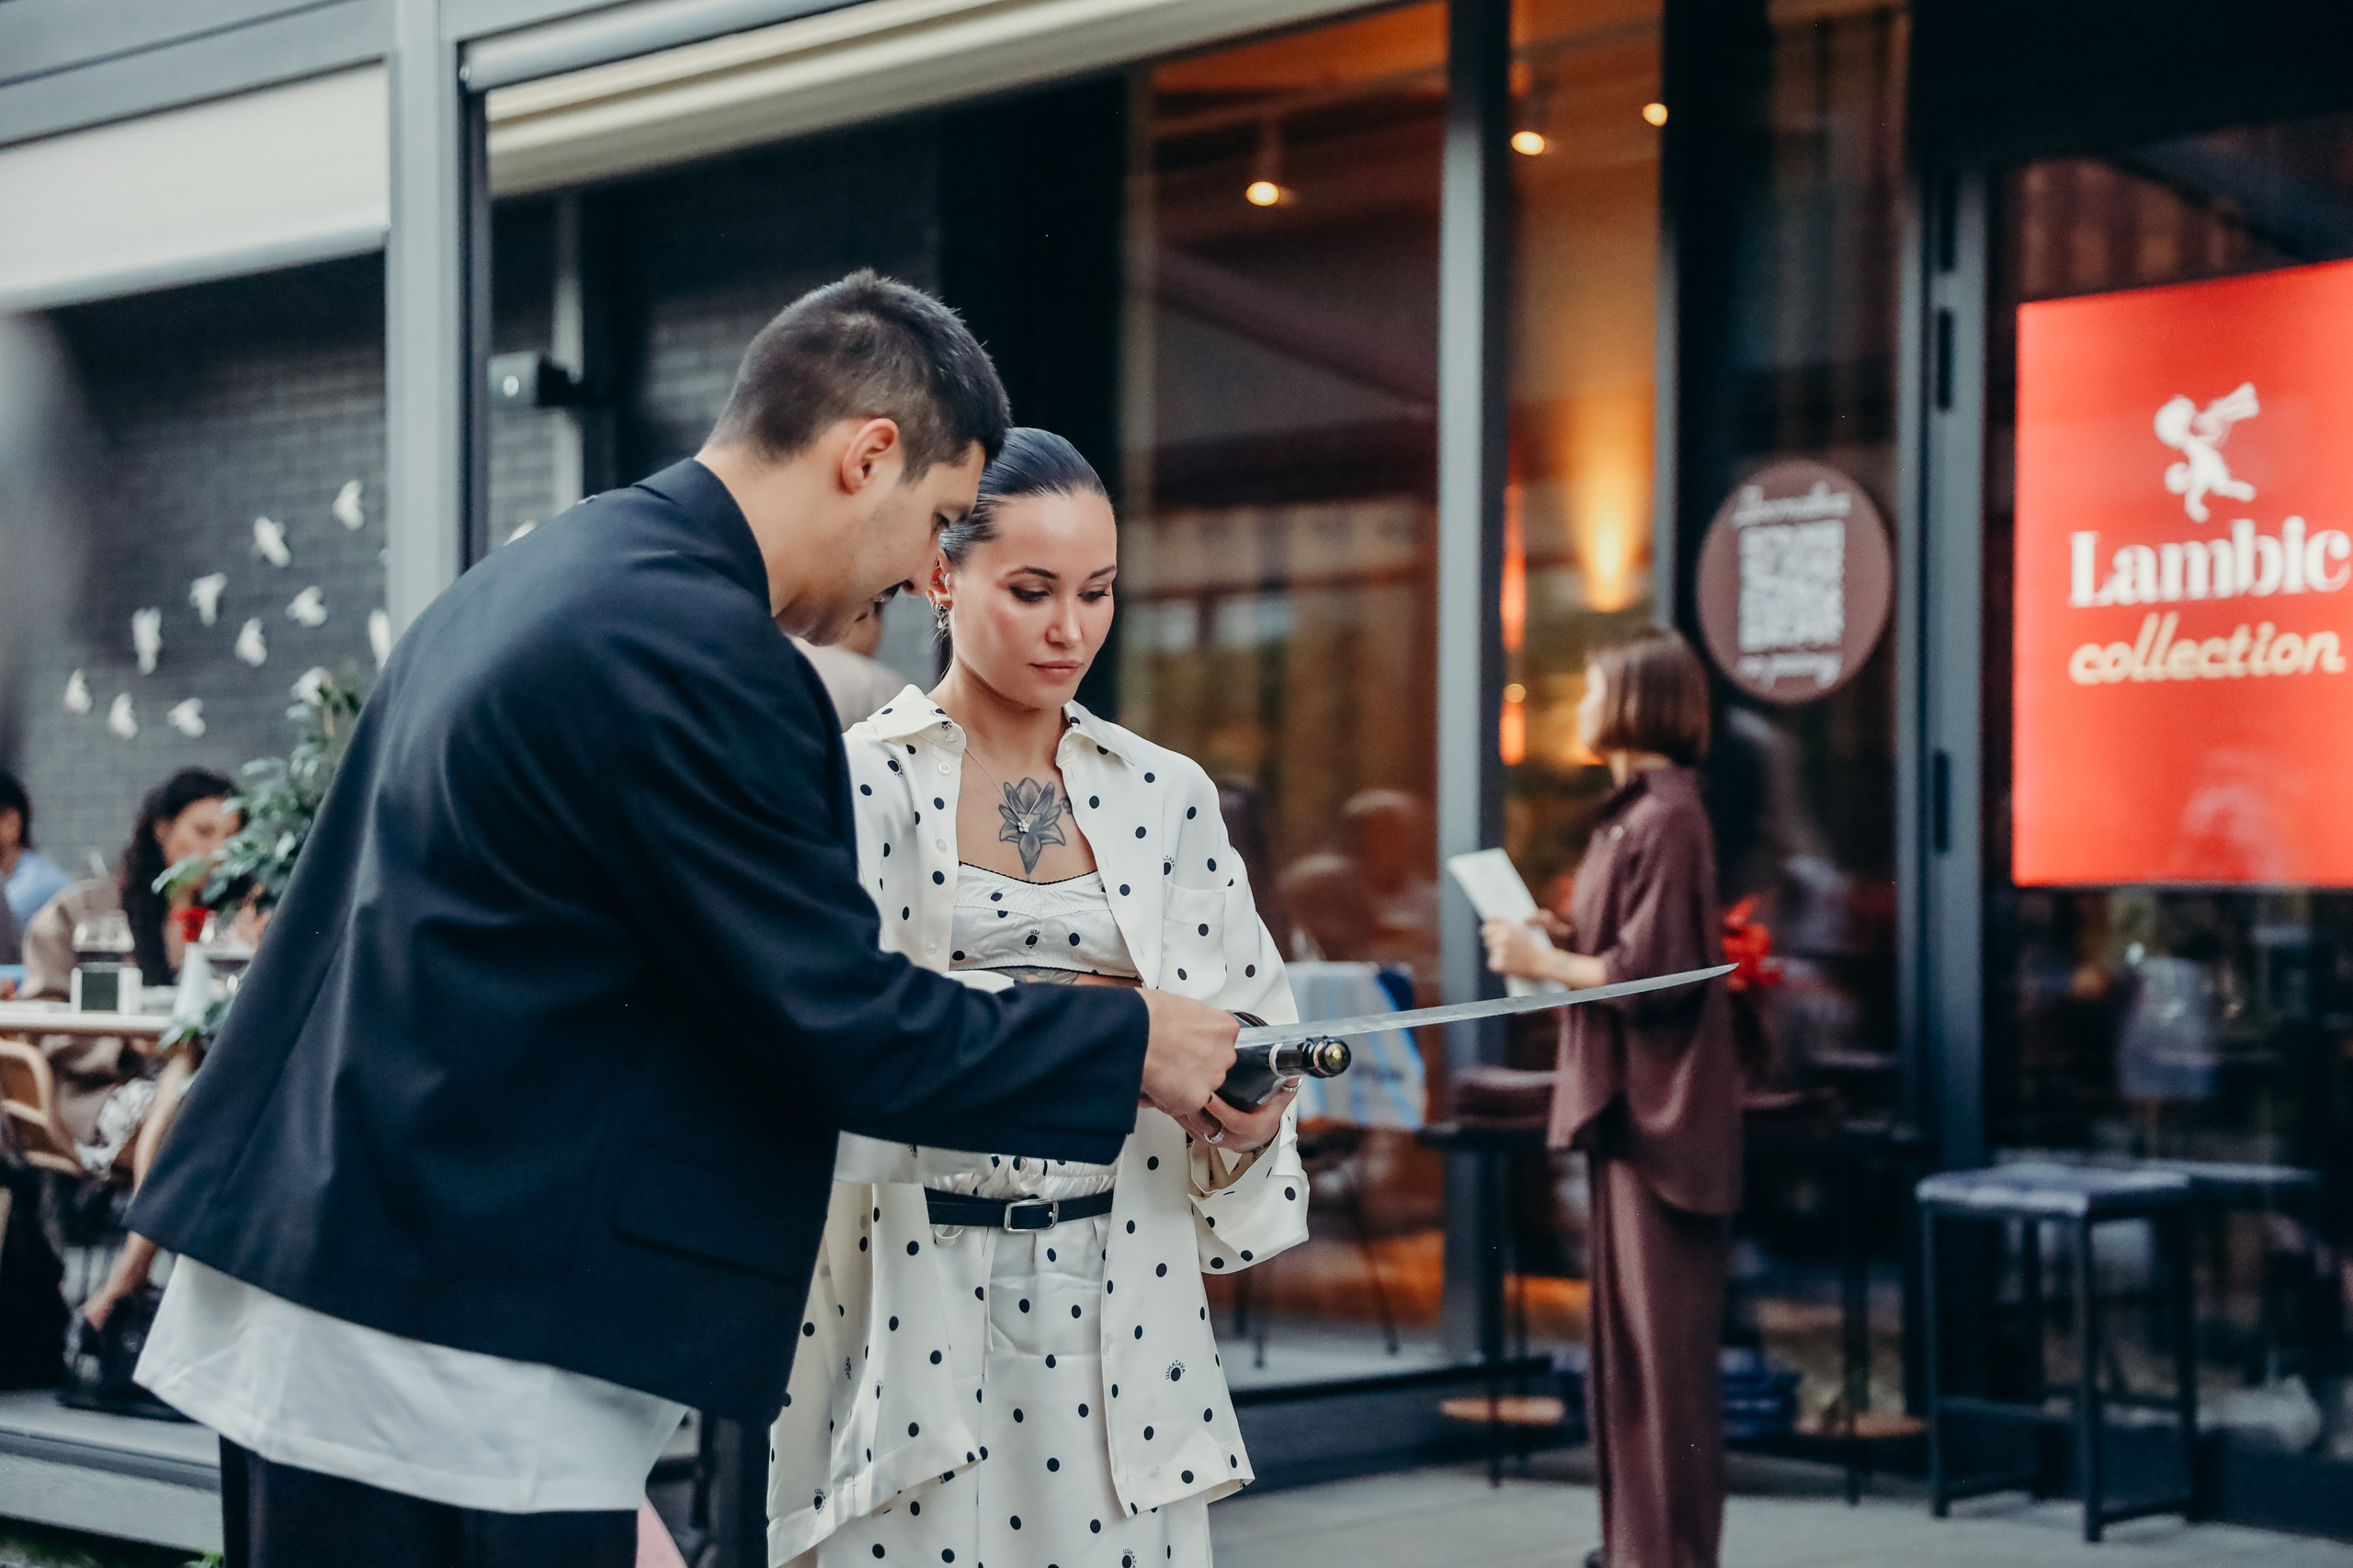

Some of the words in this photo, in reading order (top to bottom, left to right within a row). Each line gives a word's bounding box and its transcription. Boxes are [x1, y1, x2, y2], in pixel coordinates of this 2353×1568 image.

[2070, 516, 2351, 608] Lambic
[2069, 610, 2346, 685] collection
[1165, 1359, 1186, 1381] USHATAVA
